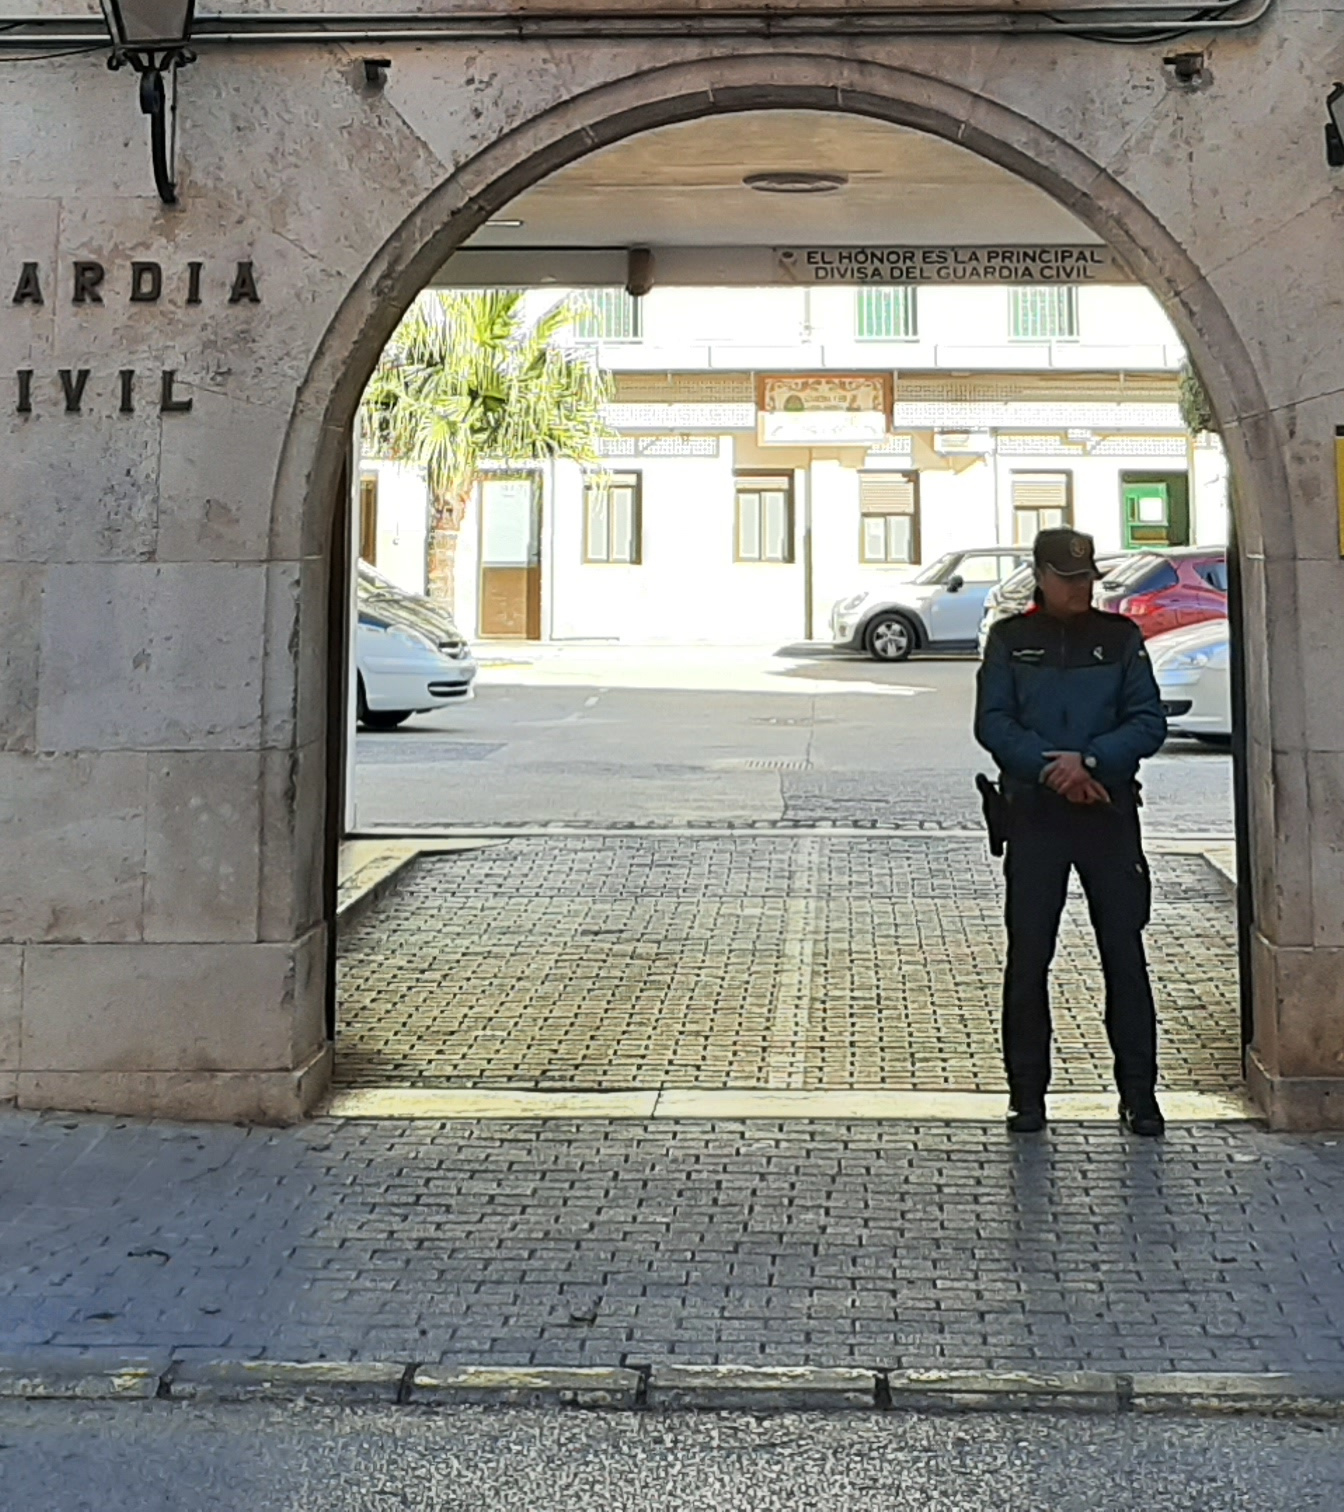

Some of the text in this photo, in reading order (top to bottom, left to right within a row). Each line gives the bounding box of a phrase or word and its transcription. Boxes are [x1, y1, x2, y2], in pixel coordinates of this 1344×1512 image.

[807, 249, 1103, 265] EL HONOR ES LA PRINCIPAL
[815, 265, 1095, 280] DIVISA DEL GUARDIA CIVIL
